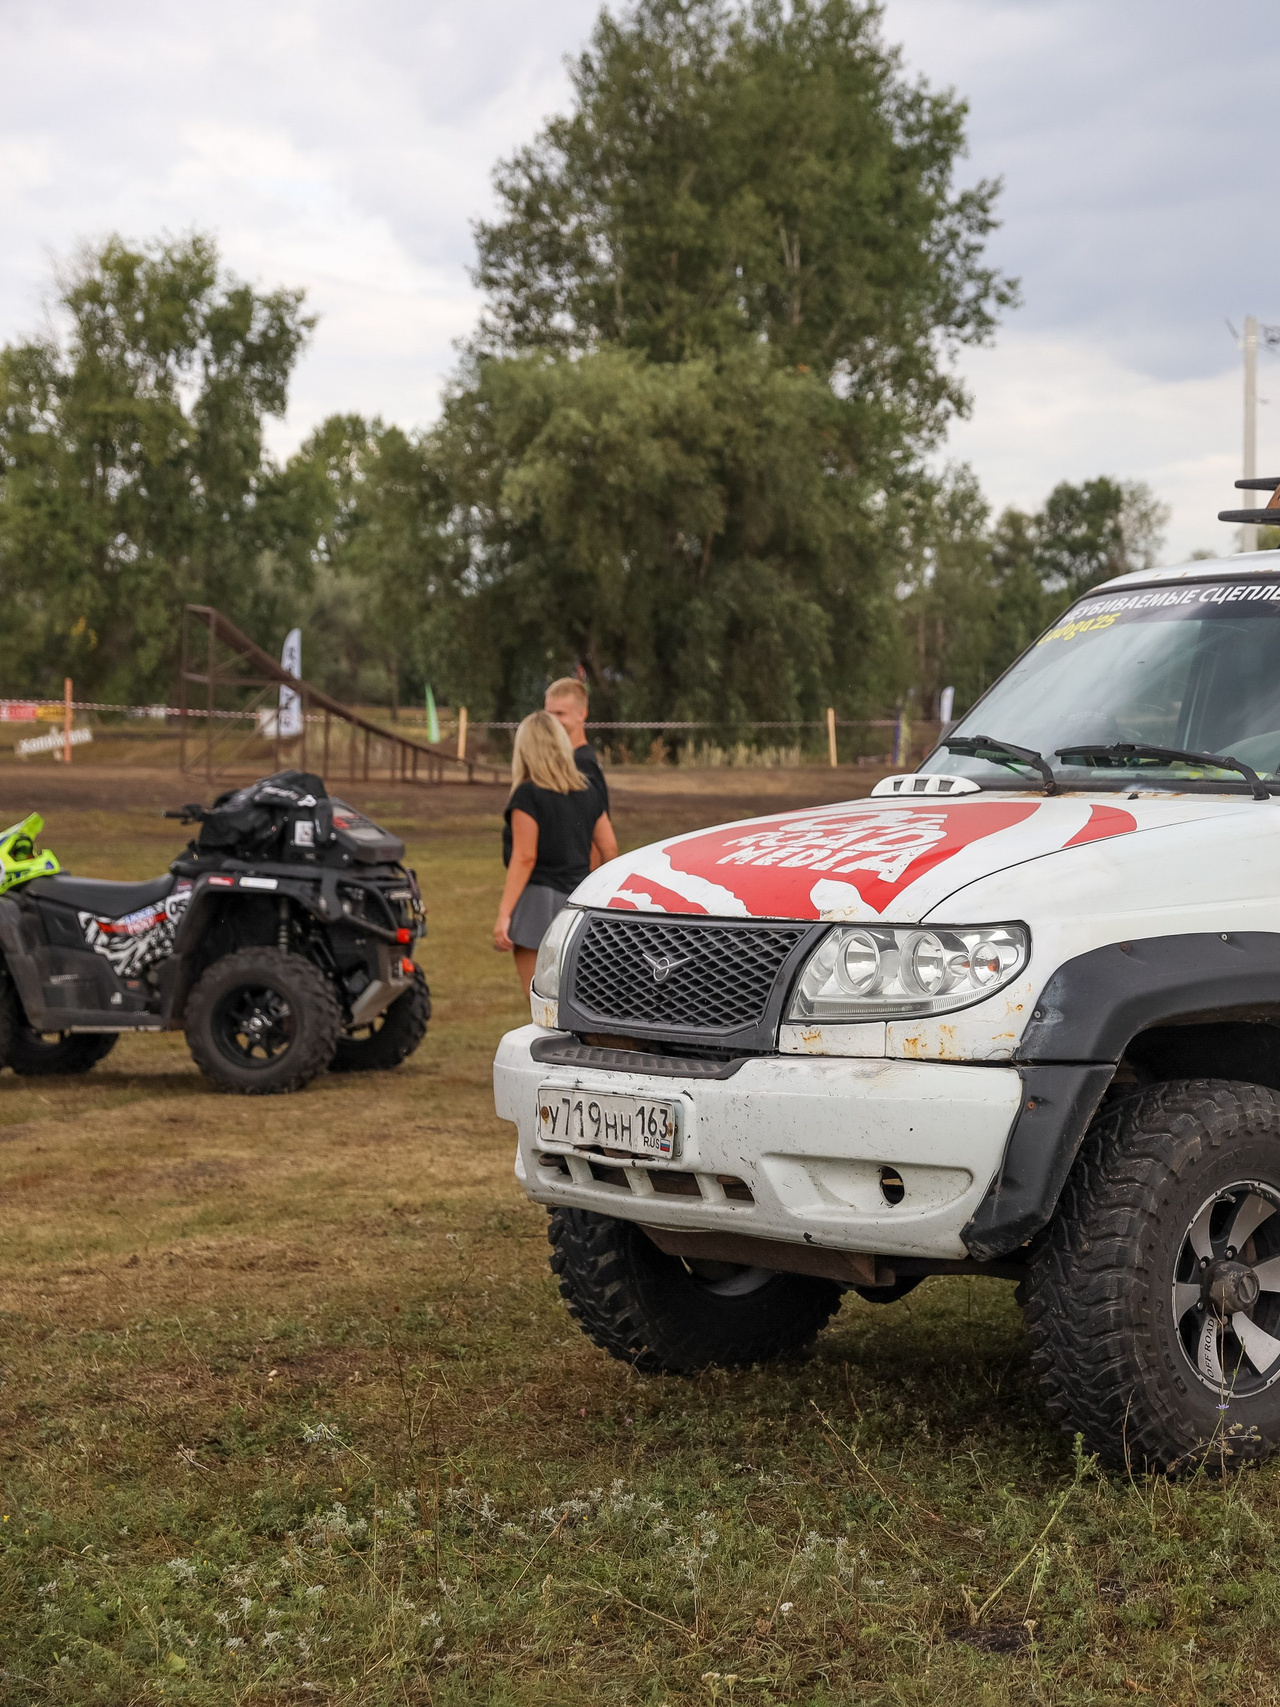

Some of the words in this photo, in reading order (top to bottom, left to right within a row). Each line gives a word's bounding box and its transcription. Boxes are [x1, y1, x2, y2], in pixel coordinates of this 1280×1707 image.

[1057, 588, 1202, 627] НЕУБИВАЕМЫЕ
[721, 828, 948, 853] ROAD
[715, 842, 940, 883] MEDIA
[548, 1096, 633, 1147] У719НН
[635, 1105, 669, 1139] 163
[643, 1135, 660, 1150] RUS
[1204, 1318, 1215, 1352] ROAD
[1204, 1353, 1215, 1378] OFF
